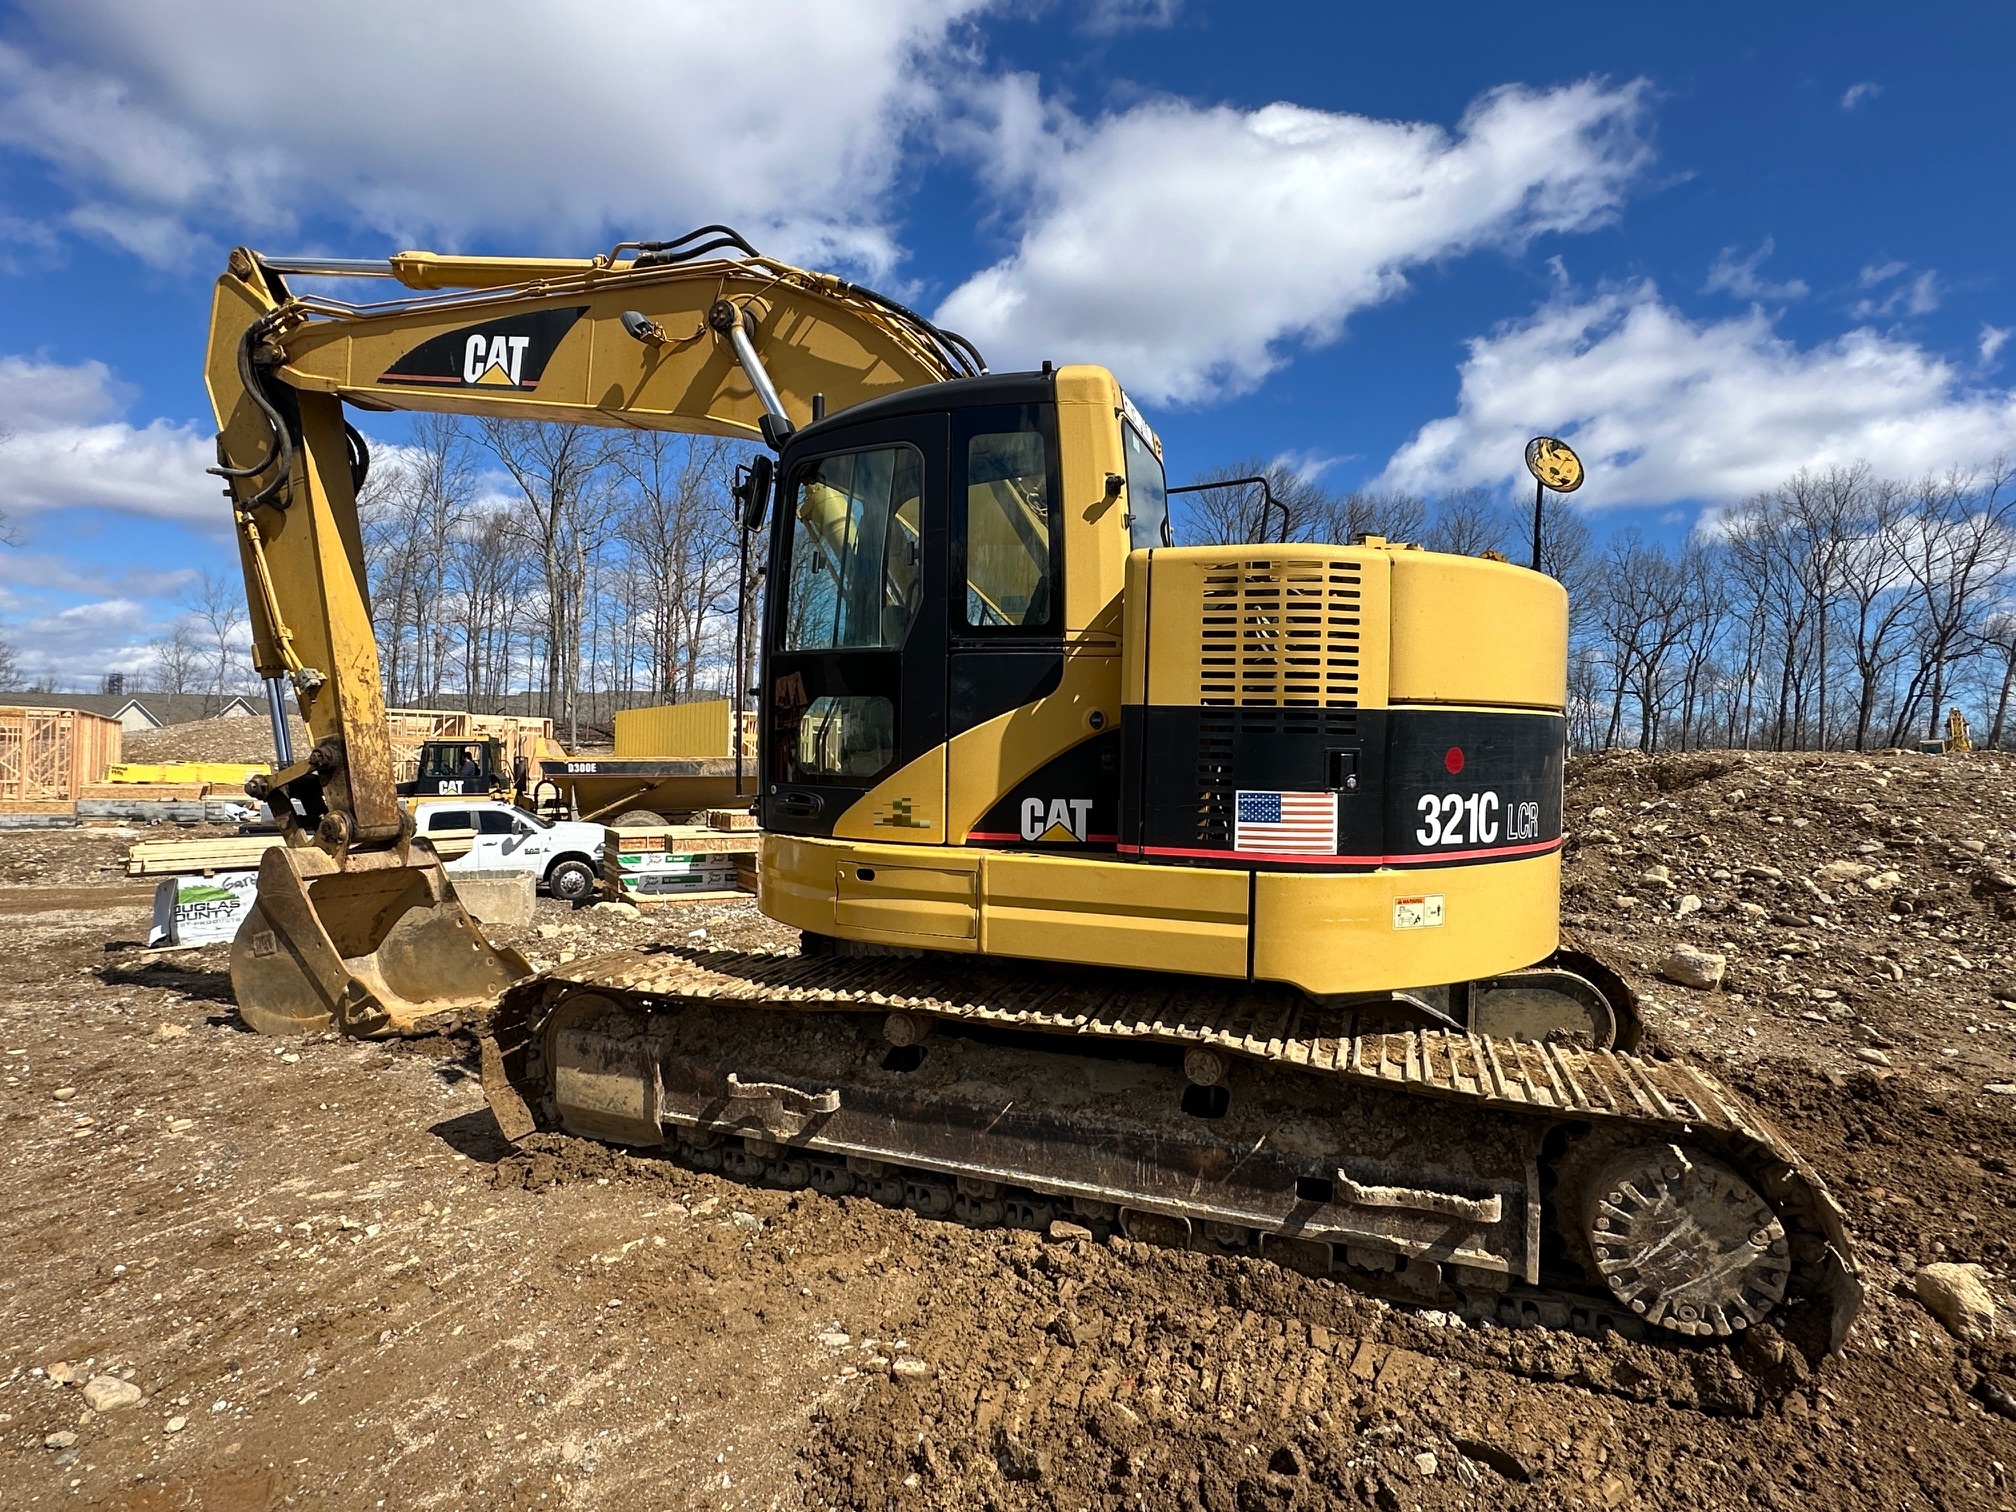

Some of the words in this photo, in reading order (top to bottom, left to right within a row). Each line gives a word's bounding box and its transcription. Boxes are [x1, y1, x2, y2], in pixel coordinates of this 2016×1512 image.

[463, 334, 530, 386] CAT
[567, 763, 597, 773] D300E
[438, 780, 464, 795] CAT
[1021, 797, 1093, 842] CAT
[1416, 790, 1499, 847] 321C
[1506, 801, 1539, 840] LCR
[174, 900, 241, 914] OUGLAS
[174, 909, 234, 923] OUNTY
